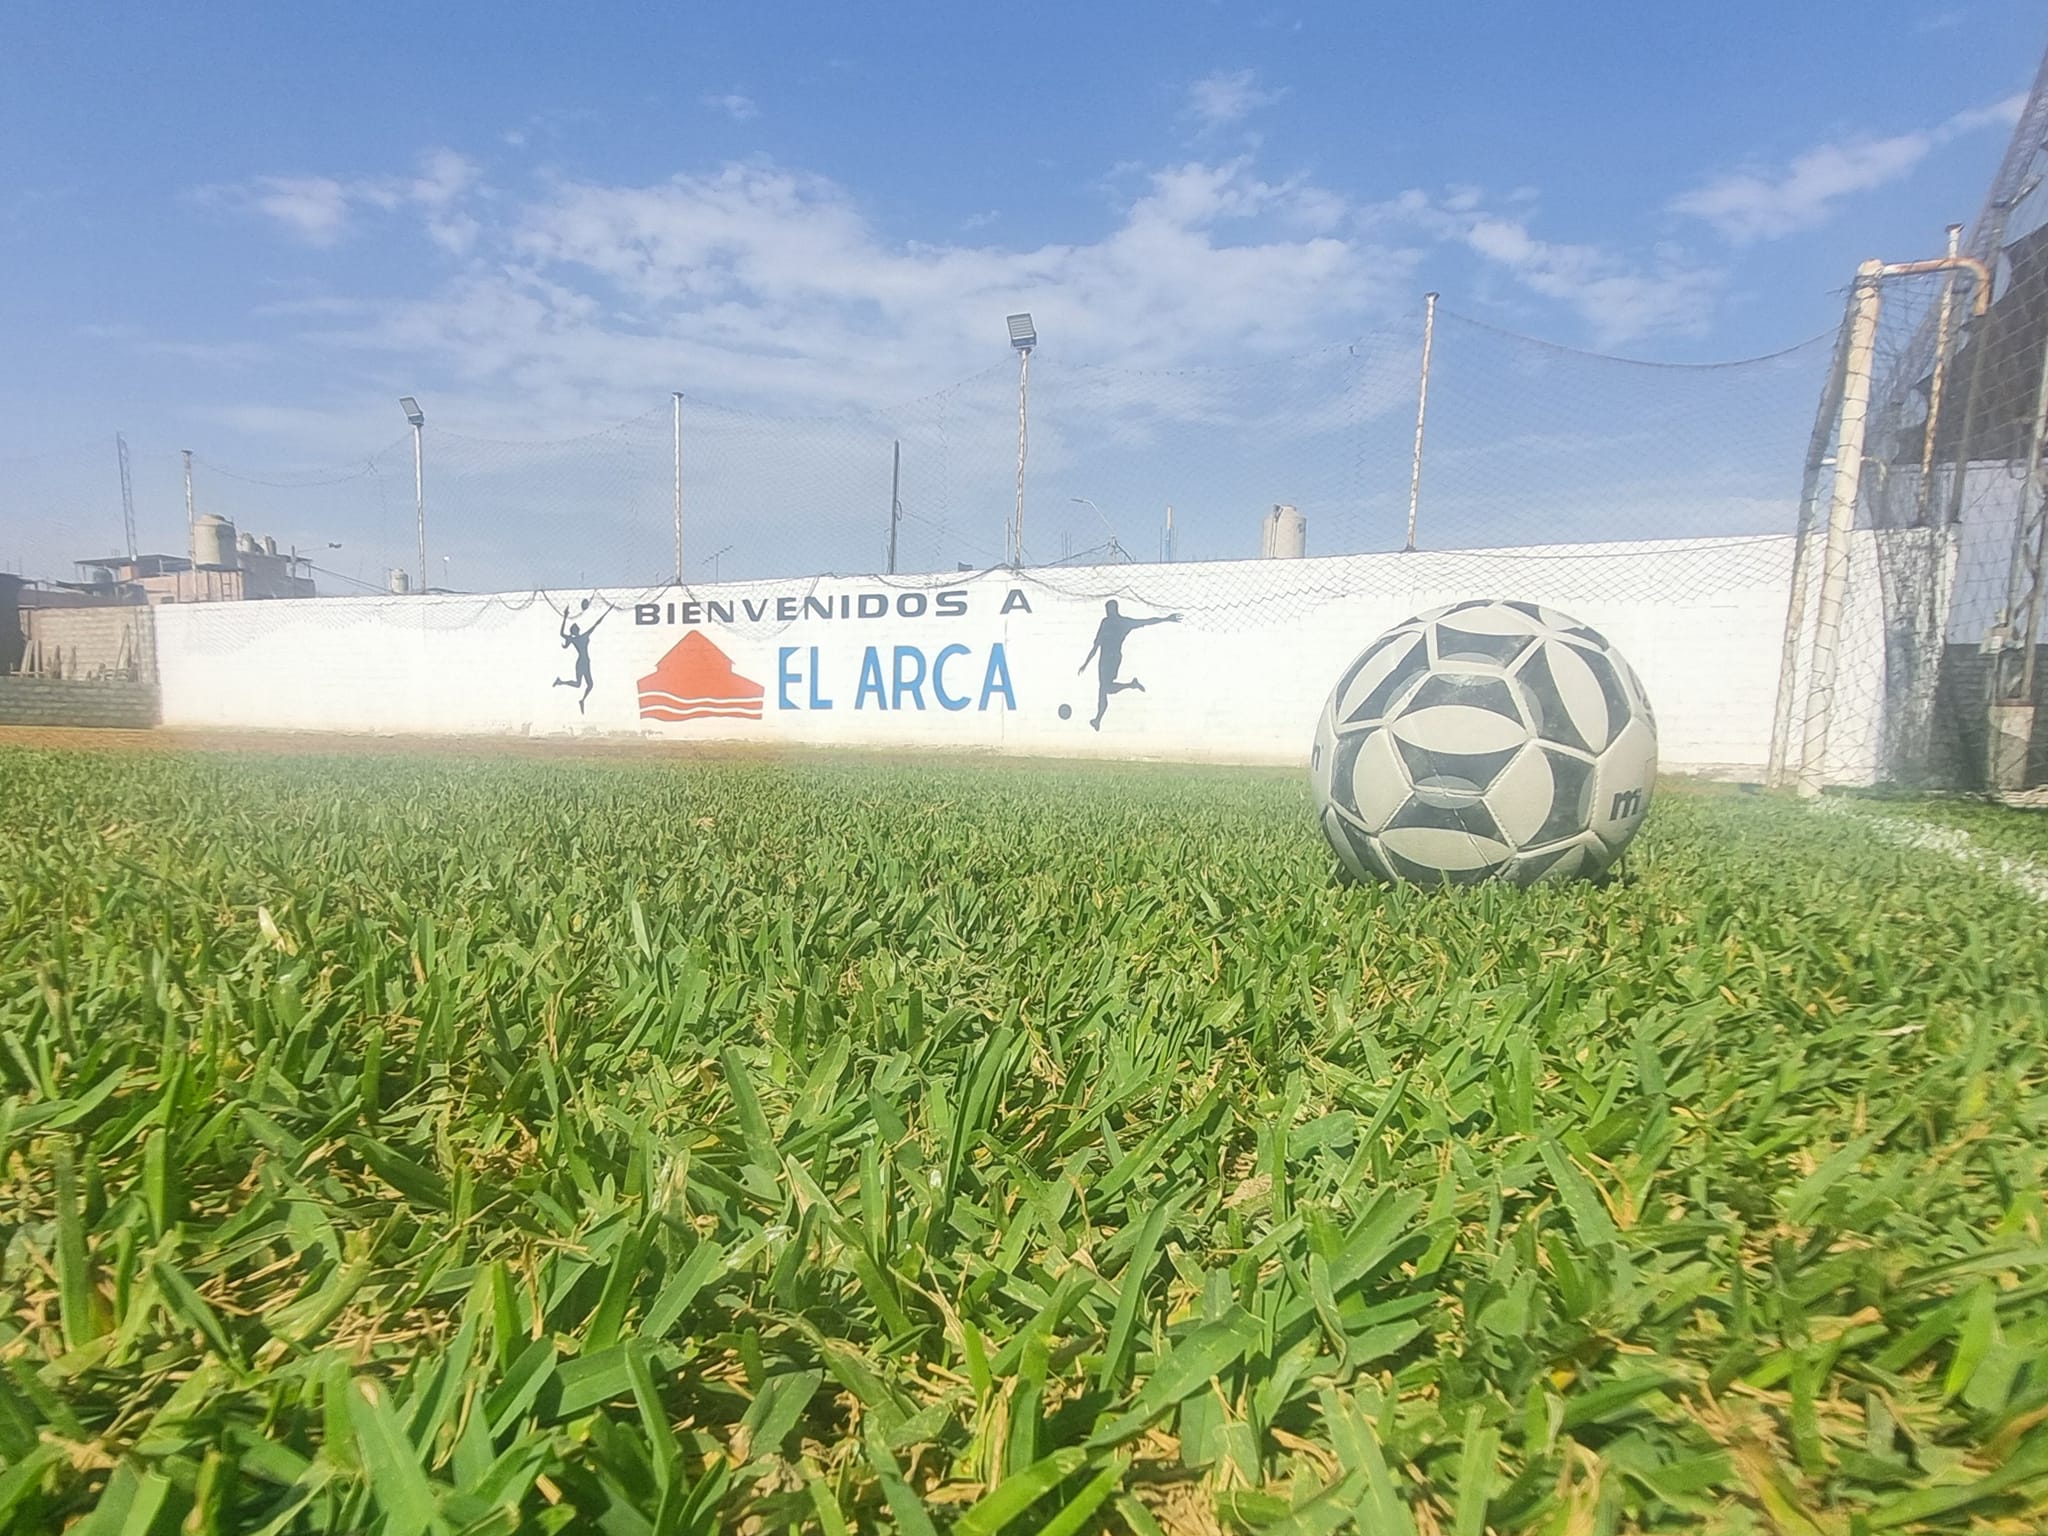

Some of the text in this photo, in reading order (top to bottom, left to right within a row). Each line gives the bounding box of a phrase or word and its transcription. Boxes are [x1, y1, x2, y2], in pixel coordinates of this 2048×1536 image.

[635, 588, 1033, 625] BIENVENIDOS A
[778, 642, 1017, 712] EL ARCA
